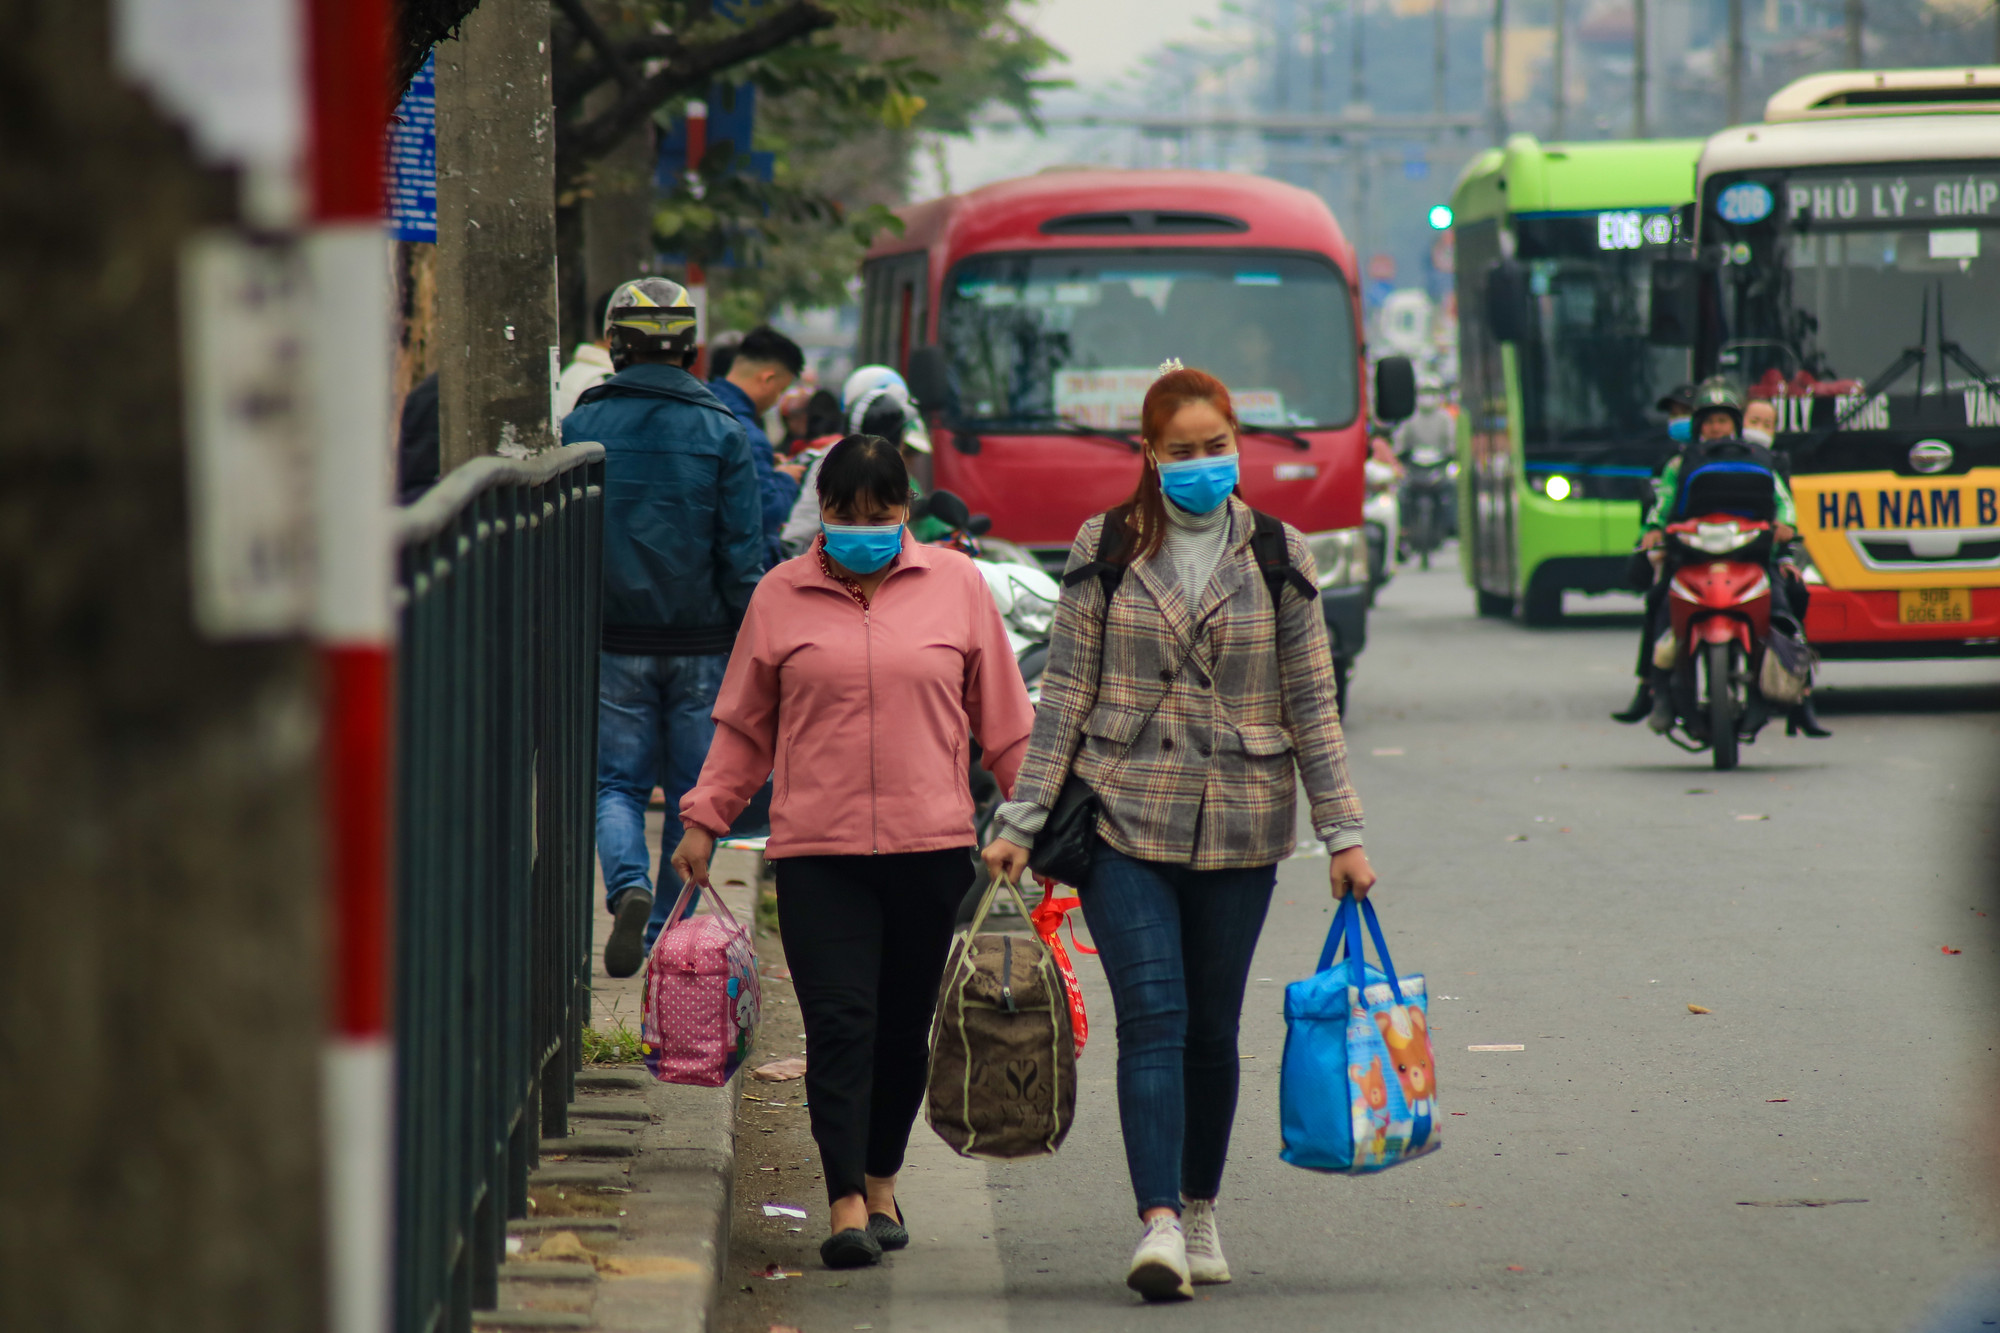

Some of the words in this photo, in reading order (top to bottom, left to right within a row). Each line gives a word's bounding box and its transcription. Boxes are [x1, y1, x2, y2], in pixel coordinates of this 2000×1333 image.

[1725, 187, 1765, 219] 206
[1934, 175, 1999, 216] GIÁP
[1818, 491, 1865, 529] HA
[1878, 489, 1960, 527] NAM
